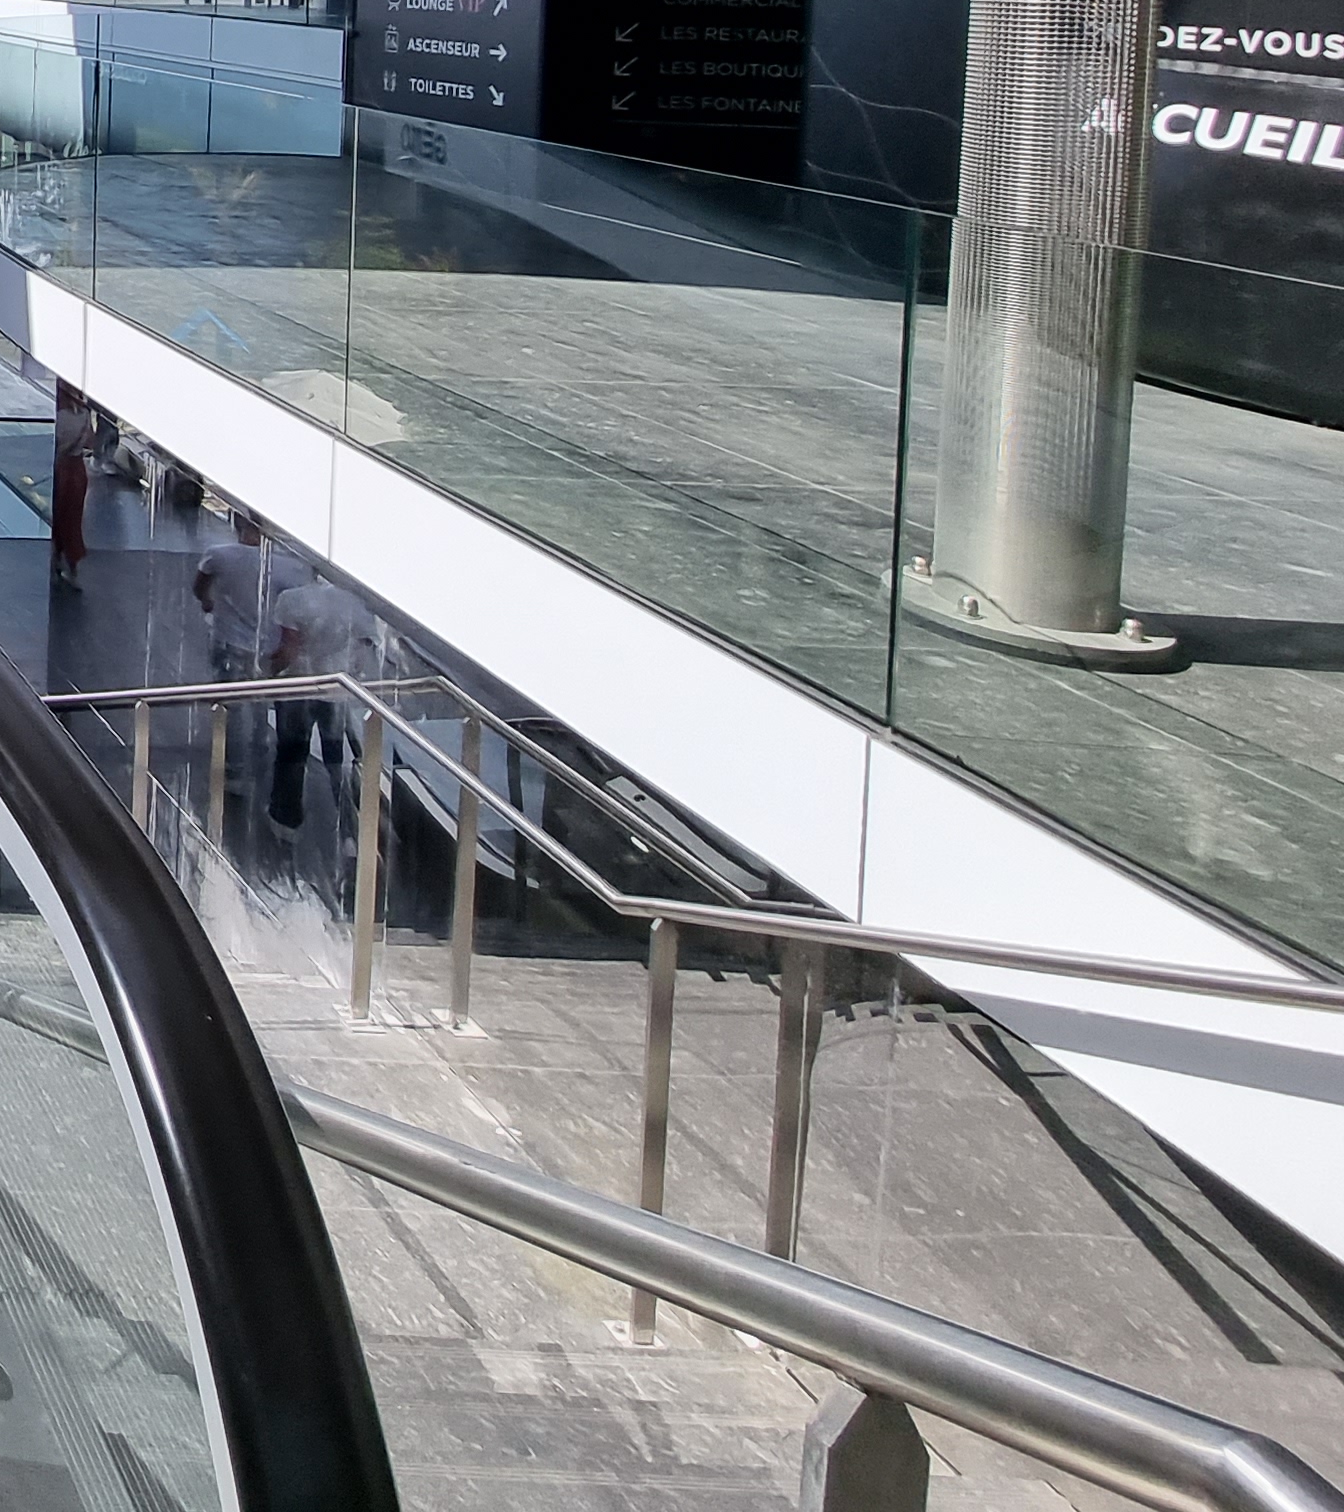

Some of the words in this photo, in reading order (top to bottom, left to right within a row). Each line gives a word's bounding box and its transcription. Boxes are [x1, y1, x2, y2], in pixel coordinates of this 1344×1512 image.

[660, 26, 698, 41] LES
[407, 38, 480, 58] ASCENSEUR
[659, 61, 697, 76] LES
[702, 62, 804, 78] BOUTIQU
[410, 78, 475, 100] TOILETTES
[657, 96, 696, 110] LES
